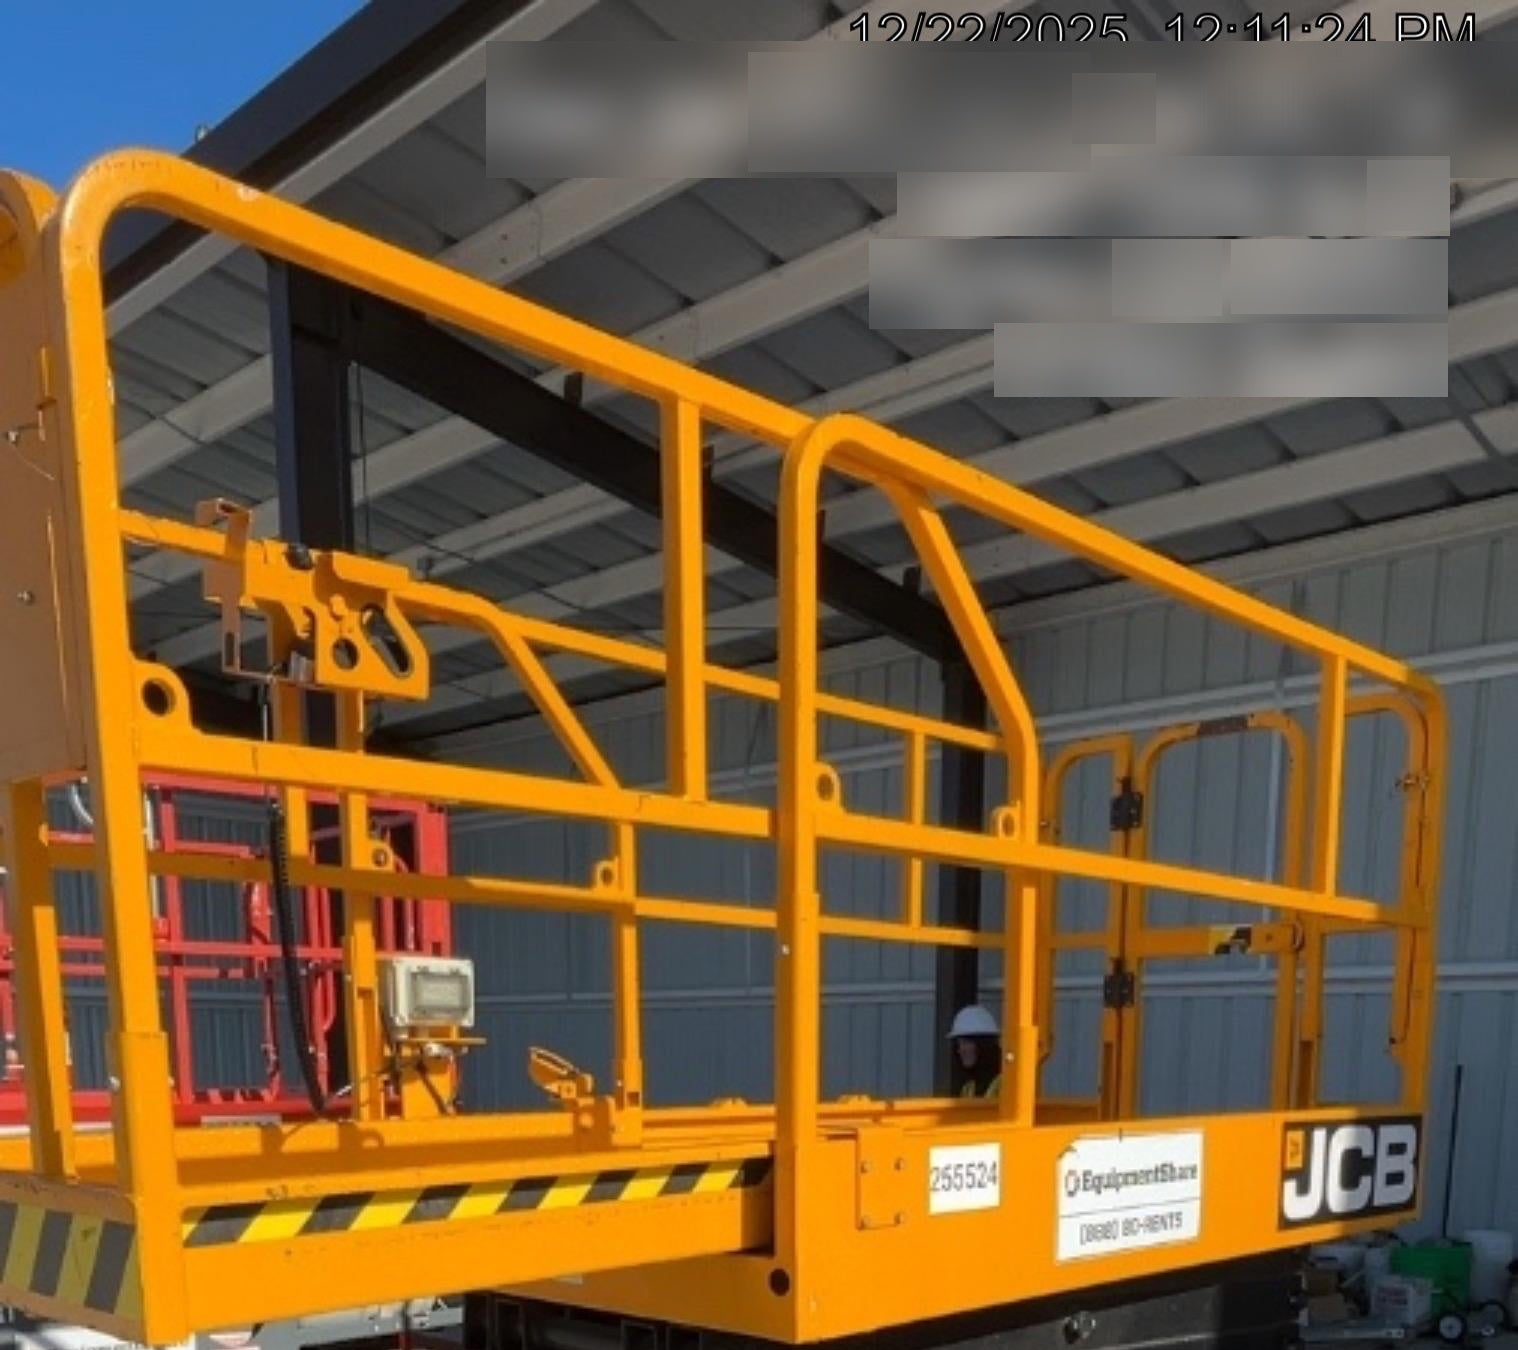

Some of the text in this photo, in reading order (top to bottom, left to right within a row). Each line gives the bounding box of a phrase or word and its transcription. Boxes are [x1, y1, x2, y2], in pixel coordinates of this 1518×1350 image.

[929, 1161, 997, 1192] 255524
[1081, 1160, 1198, 1194] EquipmentShare
[1283, 1124, 1417, 1220] JCB
